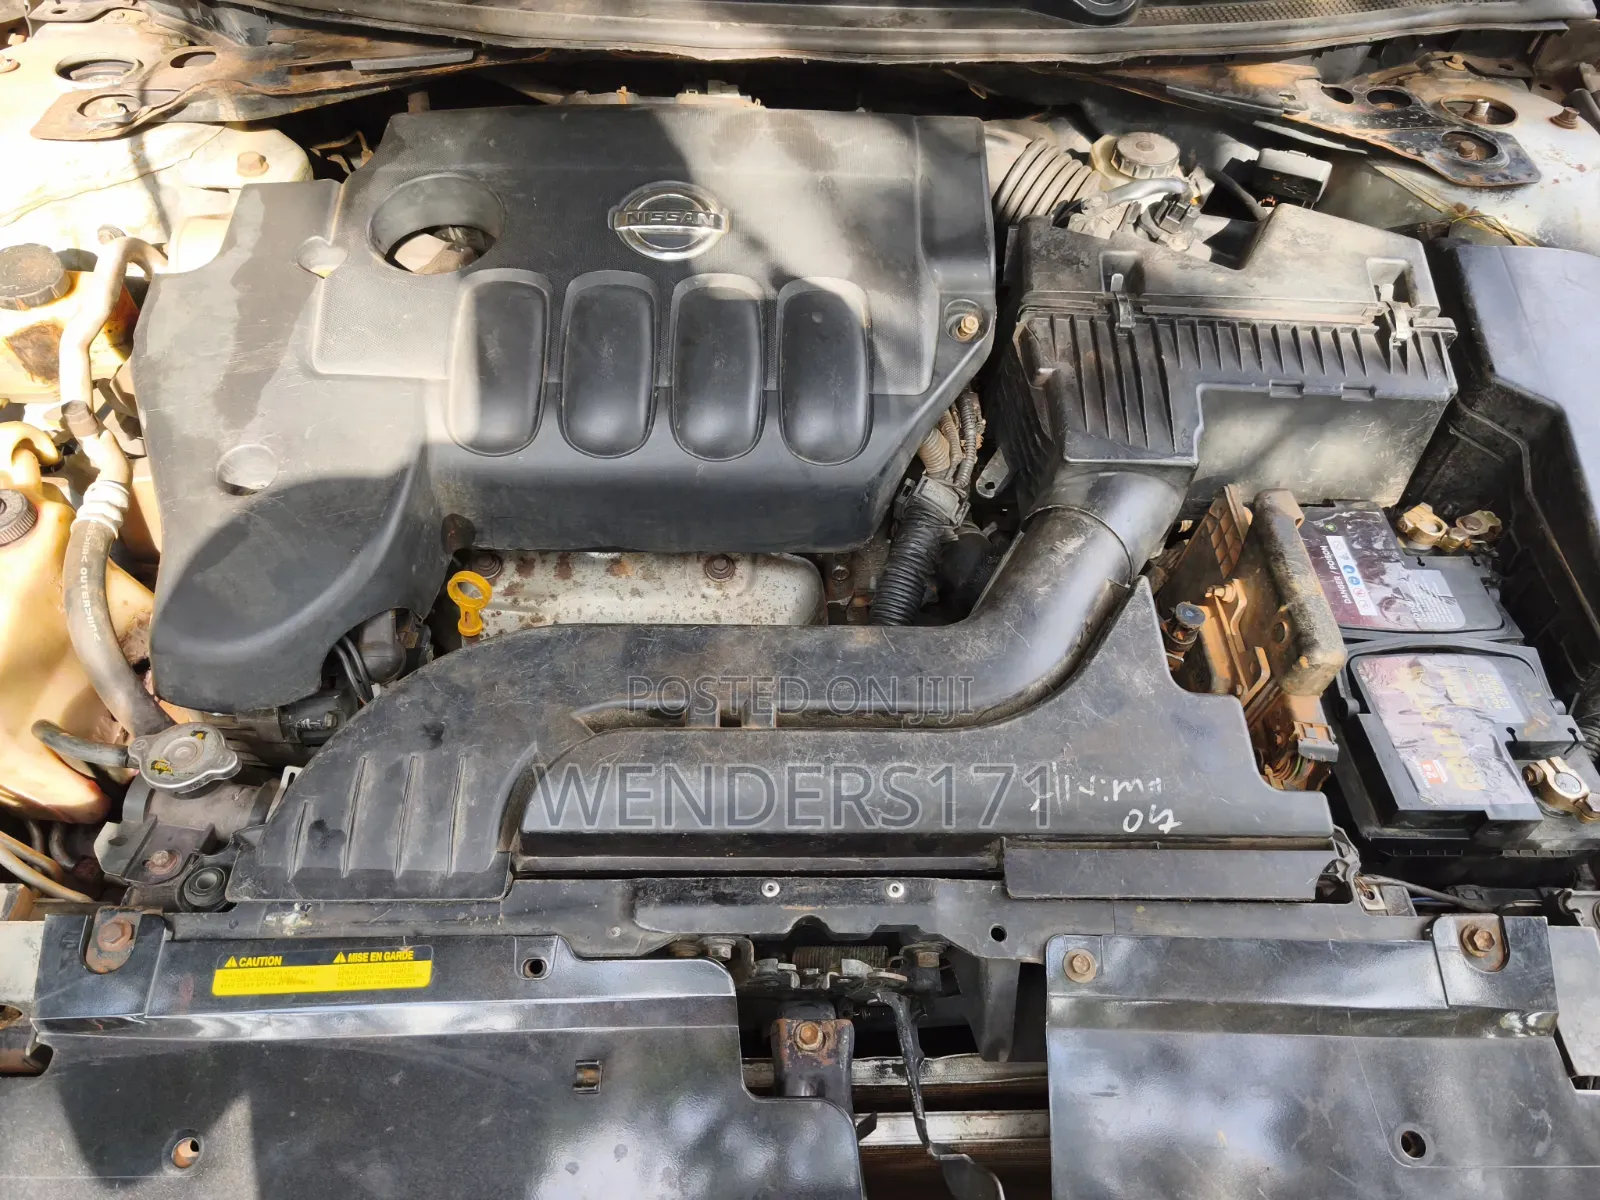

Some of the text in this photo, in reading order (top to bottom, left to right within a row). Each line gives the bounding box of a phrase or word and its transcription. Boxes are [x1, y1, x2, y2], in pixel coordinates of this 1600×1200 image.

[625, 211, 715, 226] NISSAN
[1320, 545, 1338, 570] POISON
[1333, 575, 1354, 604] DANGER
[238, 955, 283, 968] CAUTION
[347, 950, 414, 963] MISE EN GARDE
